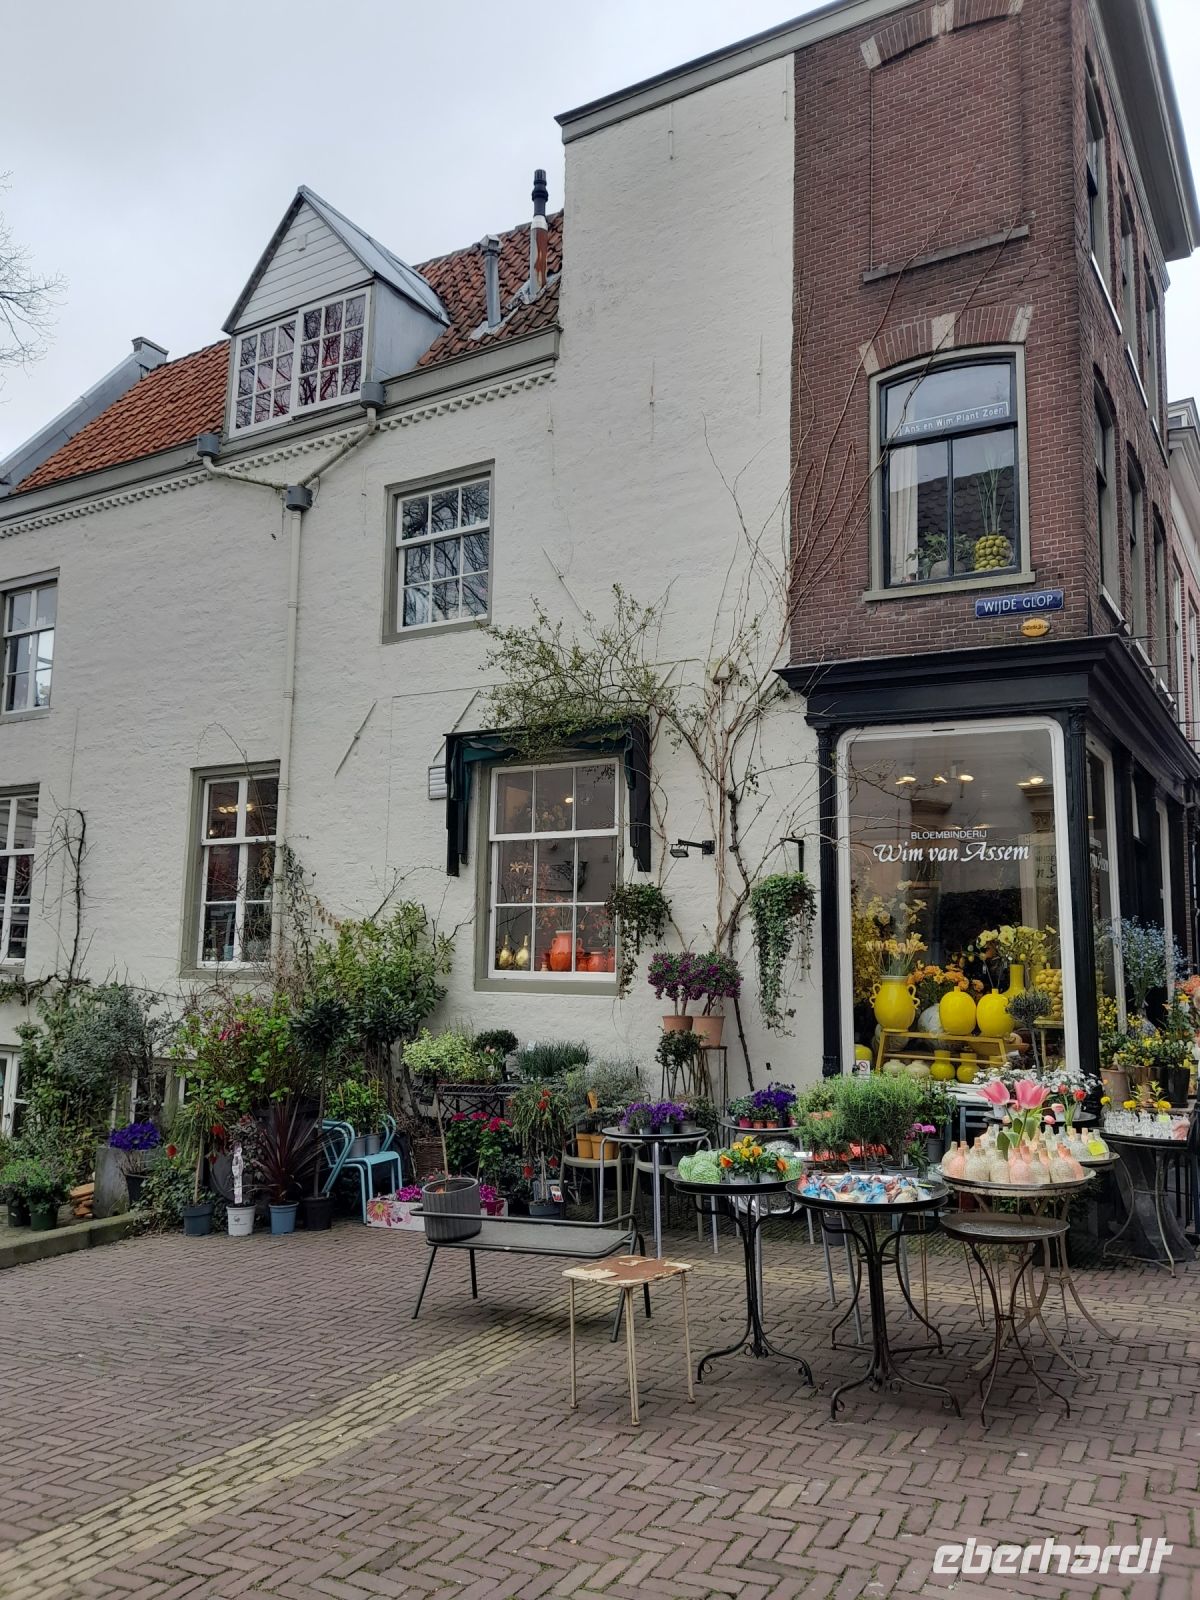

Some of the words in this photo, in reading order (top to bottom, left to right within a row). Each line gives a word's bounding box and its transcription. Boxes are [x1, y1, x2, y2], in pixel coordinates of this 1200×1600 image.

[904, 425, 920, 435] Ans
[923, 422, 933, 430] en
[936, 417, 953, 428] Wim
[956, 412, 979, 423] Plant
[983, 406, 1004, 418] Zoen
[984, 599, 1017, 614] WIJDE
[1023, 595, 1053, 608] GLOP
[911, 830, 987, 840] BLOEMBINDERIJ
[872, 841, 923, 863] Wim
[928, 847, 958, 862] van
[960, 841, 1029, 862] Assem
